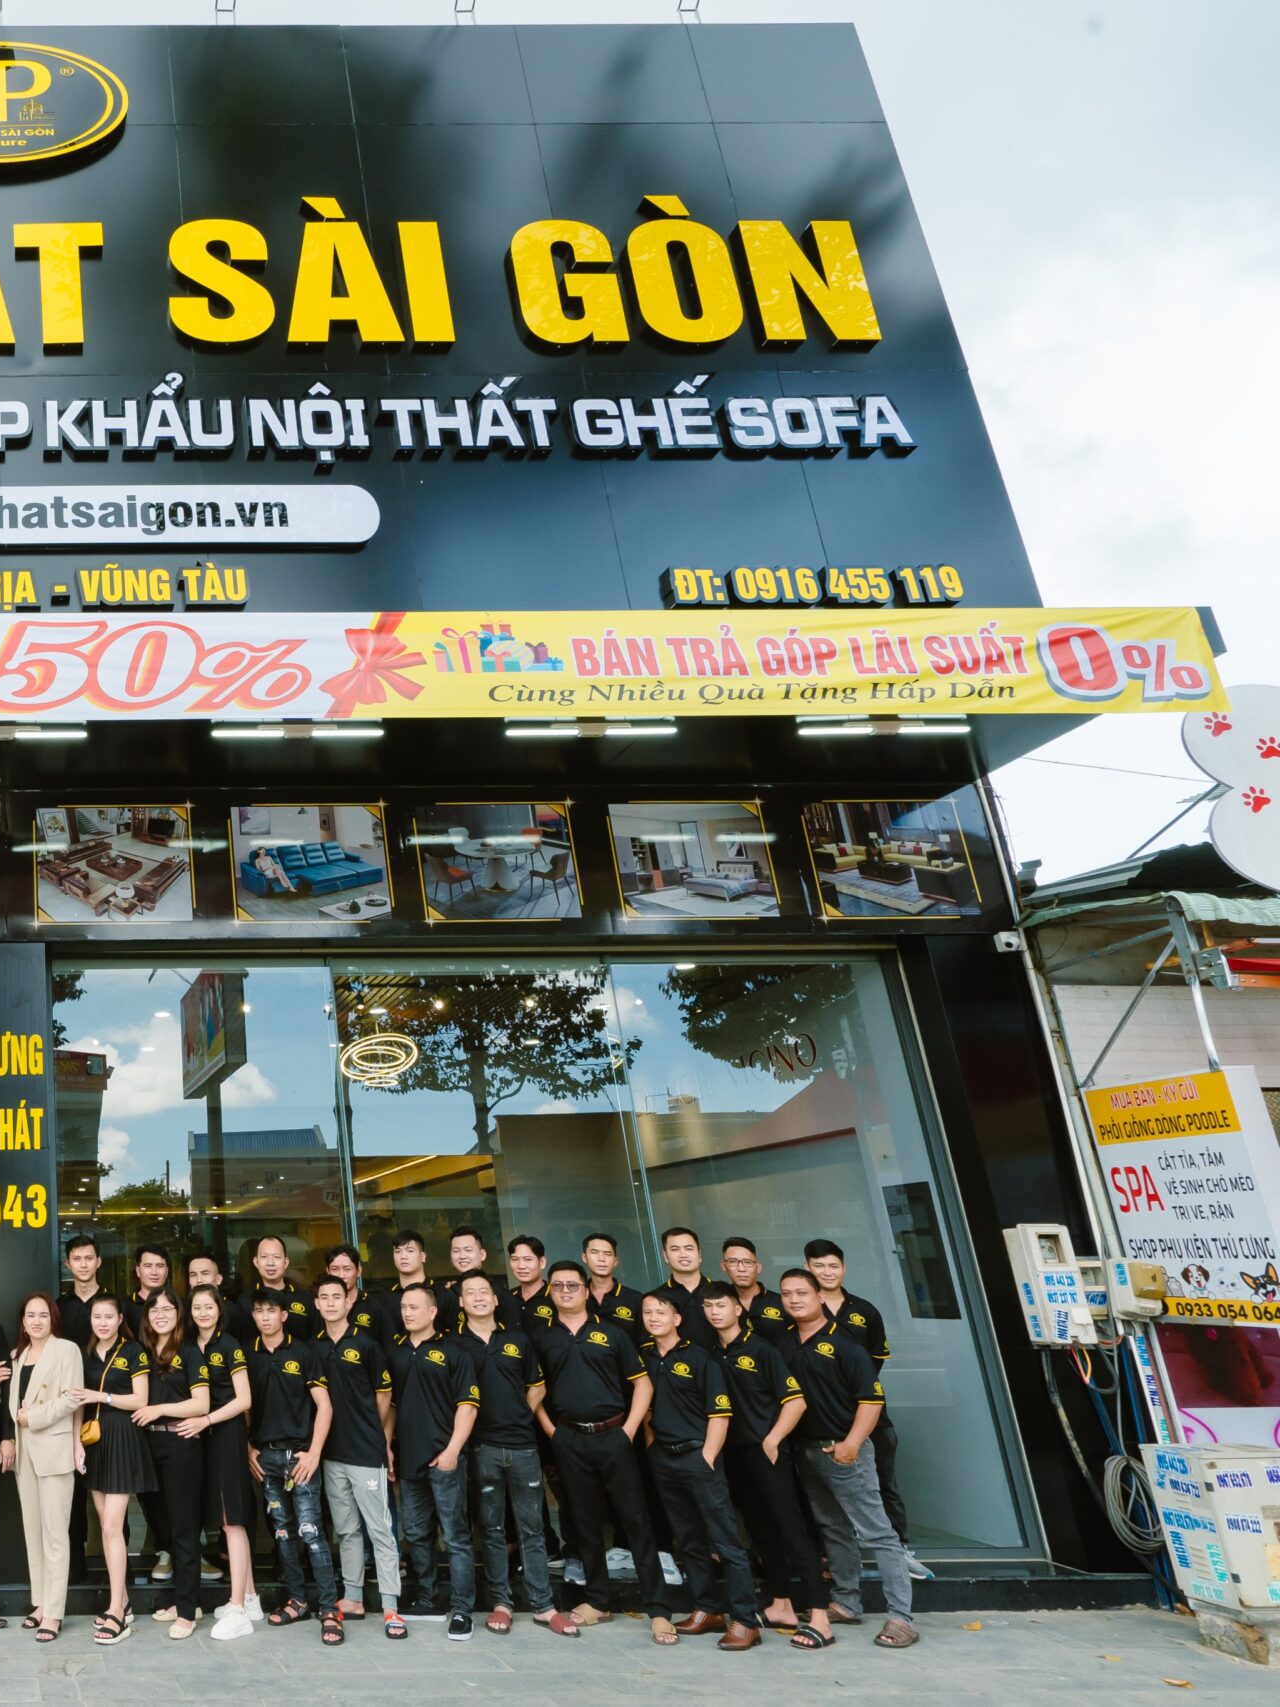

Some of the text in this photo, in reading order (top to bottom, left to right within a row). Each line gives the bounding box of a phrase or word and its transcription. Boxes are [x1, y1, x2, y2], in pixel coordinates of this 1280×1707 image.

[0, 127, 21, 137] SÀI
[24, 127, 55, 136] GÒN
[168, 197, 456, 346] SÀI
[510, 195, 882, 344] GÒN
[43, 372, 236, 453] KHẨU
[247, 382, 371, 464] NỘI
[380, 376, 558, 451] THẤT
[571, 374, 720, 452] GHẾ
[726, 393, 915, 450] SOFA
[79, 564, 172, 604] VŨNG
[182, 564, 247, 603] TÀU
[673, 565, 964, 603] ĐT: 0916 455 119
[570, 622, 1030, 677] BÁN TRẢ GÓP LÃI SUẤT
[1038, 622, 1210, 703] 0%
[488, 678, 1016, 706] Cùng Nhiều Quà Tặng Hấp Dẫn
[1109, 1092, 1133, 1110] MUA
[1123, 1114, 1155, 1138] GIỐNG
[1154, 1113, 1186, 1134] DÒNG
[1186, 1109, 1231, 1131] POODLE
[1111, 1166, 1165, 1212] SPA
[1179, 1179, 1205, 1195] SINH
[1206, 1174, 1228, 1193] CHÓ
[1171, 1205, 1192, 1222] TRỊ
[1129, 1238, 1158, 1259] SHOP
[1158, 1238, 1183, 1263] PHỤ
[1182, 1233, 1213, 1263] KIỆN
[1212, 1232, 1239, 1259] THÚ
[1176, 1302, 1213, 1317] 0933
[1217, 1304, 1248, 1320] 054
